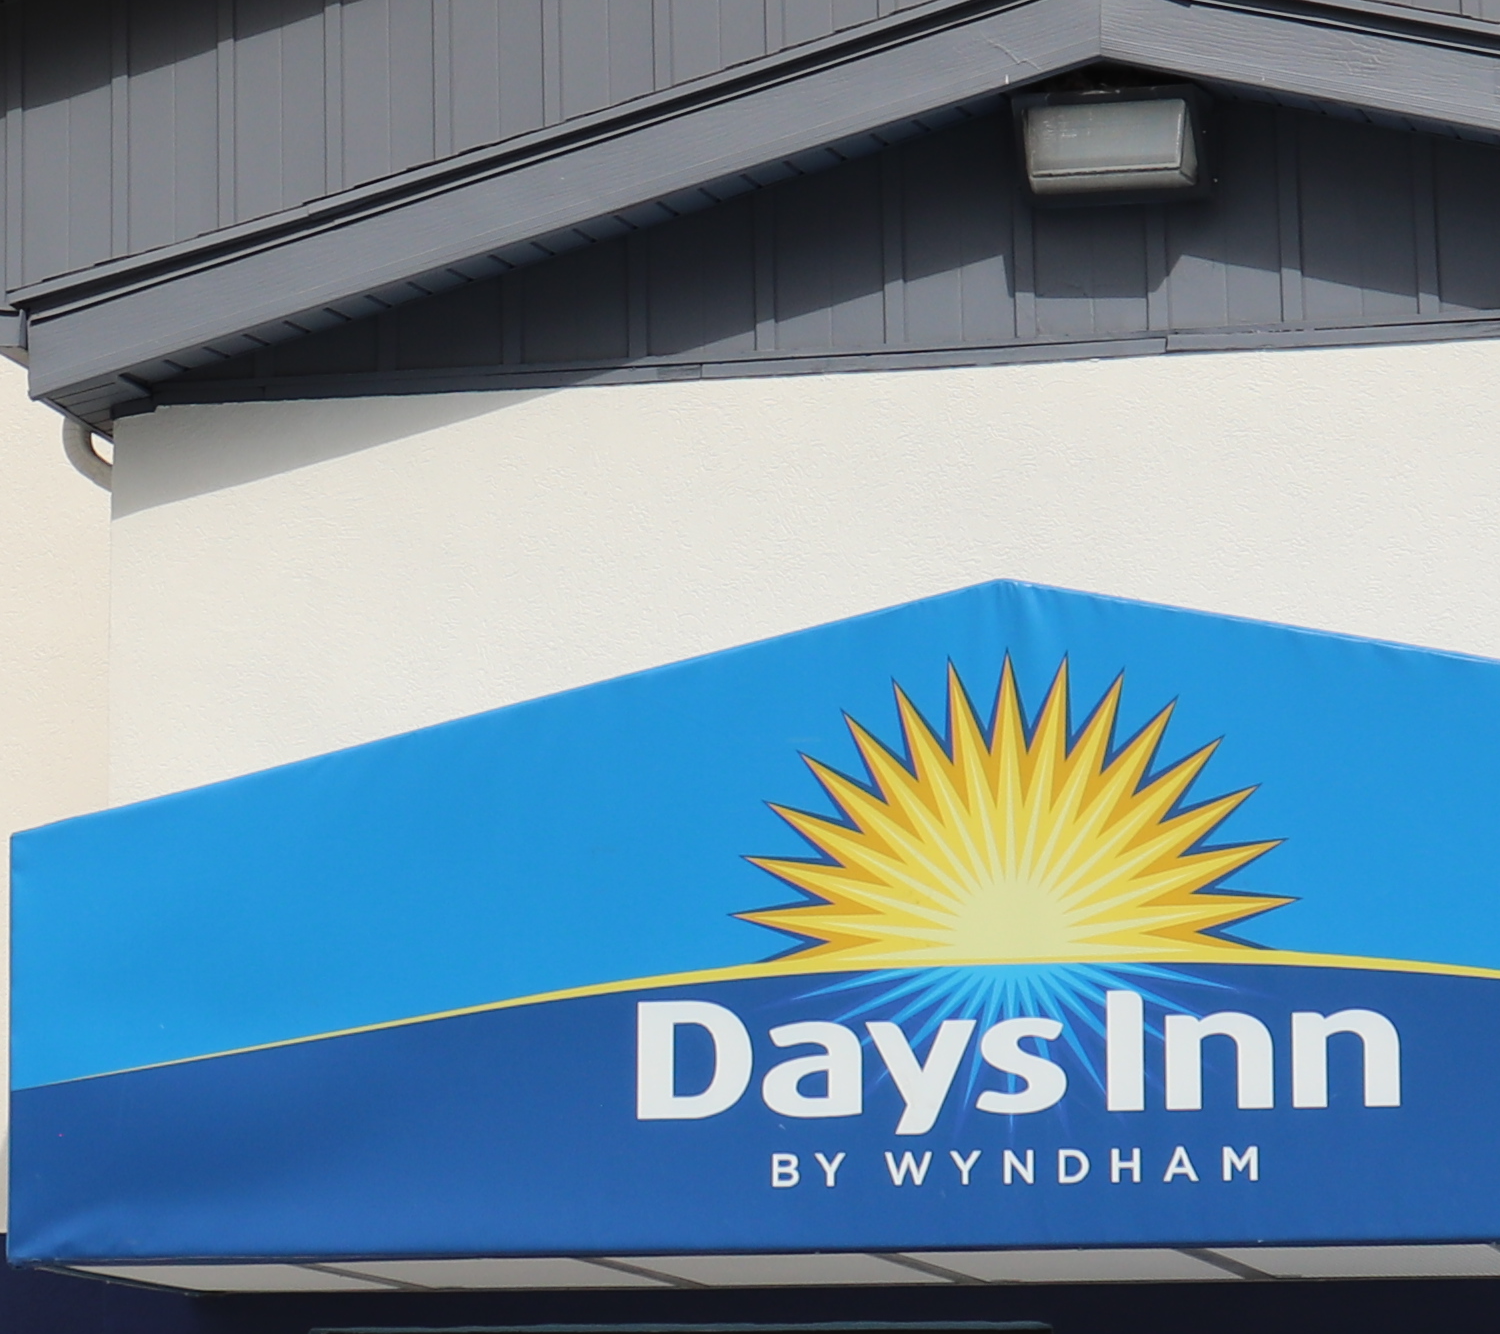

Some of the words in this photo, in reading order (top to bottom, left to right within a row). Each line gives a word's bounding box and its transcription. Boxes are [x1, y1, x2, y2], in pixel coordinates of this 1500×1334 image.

[636, 999, 1068, 1136] Days
[1106, 989, 1402, 1113] Inn
[771, 1152, 847, 1188] BY
[884, 1145, 1262, 1187] WYNDHAM
